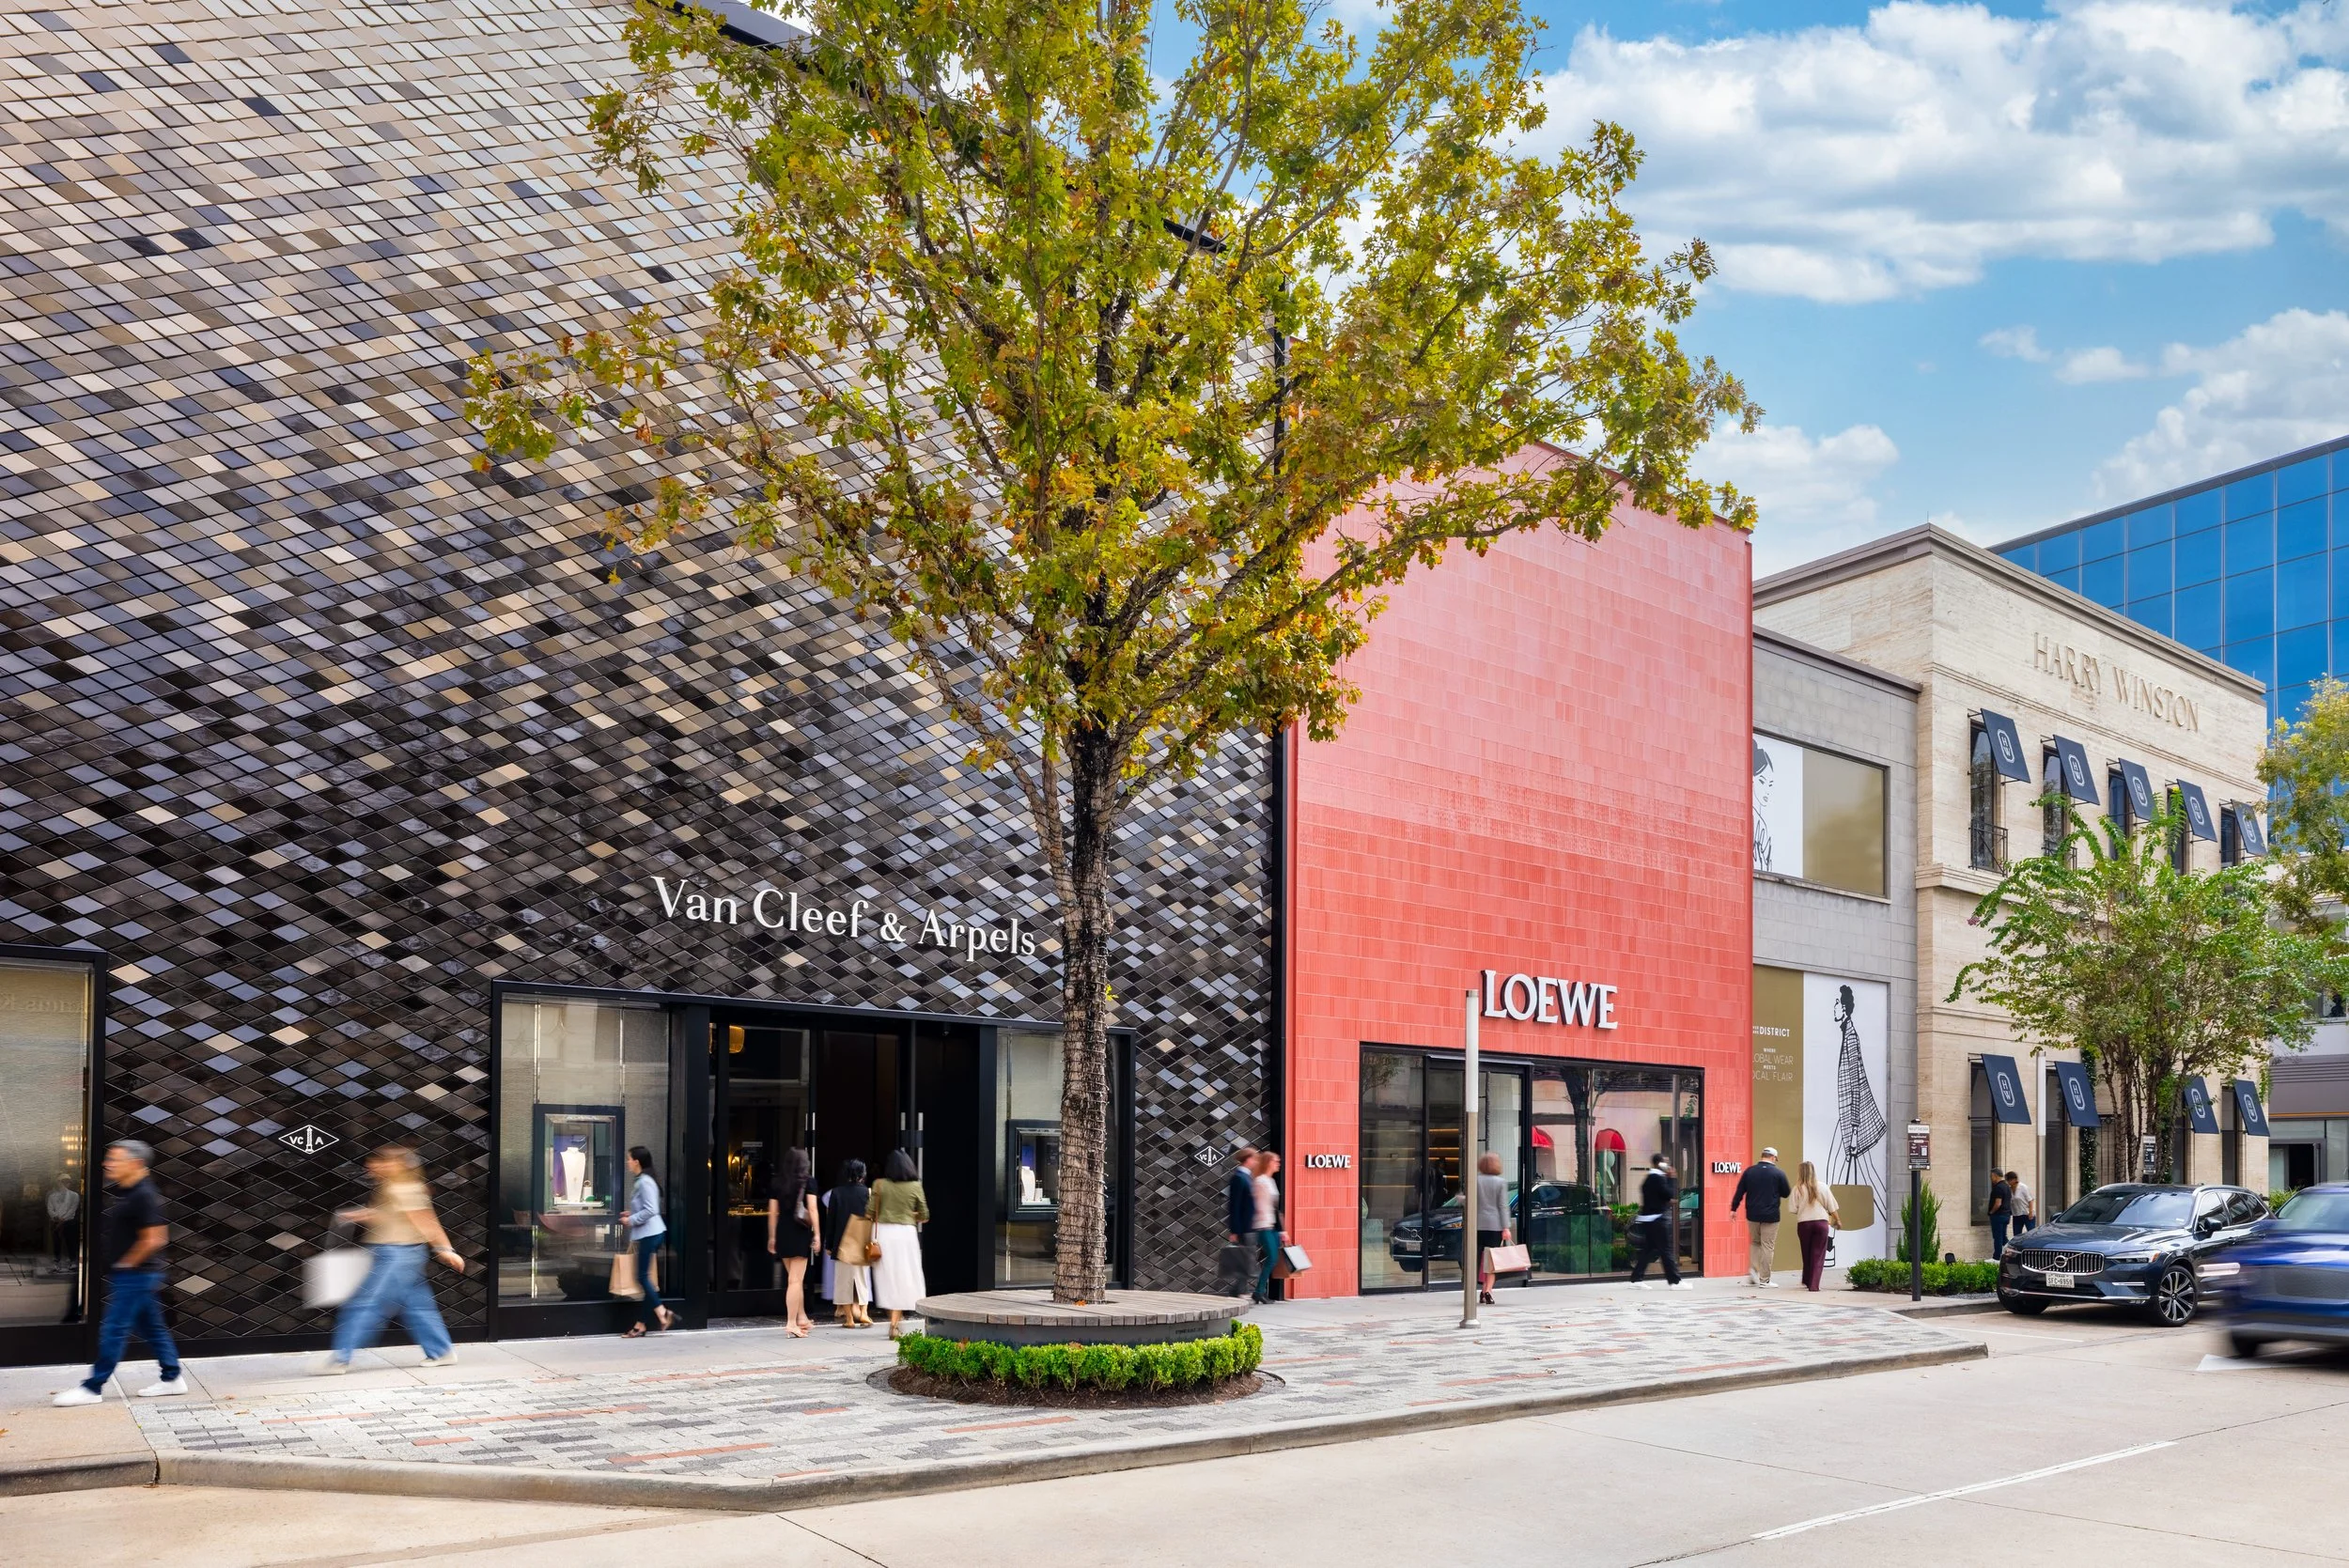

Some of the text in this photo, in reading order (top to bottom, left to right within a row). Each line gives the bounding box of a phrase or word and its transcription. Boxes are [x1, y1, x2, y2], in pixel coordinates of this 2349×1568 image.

[2033, 632, 2200, 733] HARRY WINSTON
[650, 876, 1035, 962] Van Cleef & Arpels
[1481, 969, 1618, 1030] LOEWE
[1759, 1026, 1790, 1037] DISTRICT
[1753, 1052, 1794, 1065] OBAL WEAR
[1773, 1071, 1794, 1082] FLAIR
[288, 1136, 324, 1145] VC A
[1305, 1154, 1352, 1169] LOEWE
[1712, 1161, 1742, 1173] LOEWE
